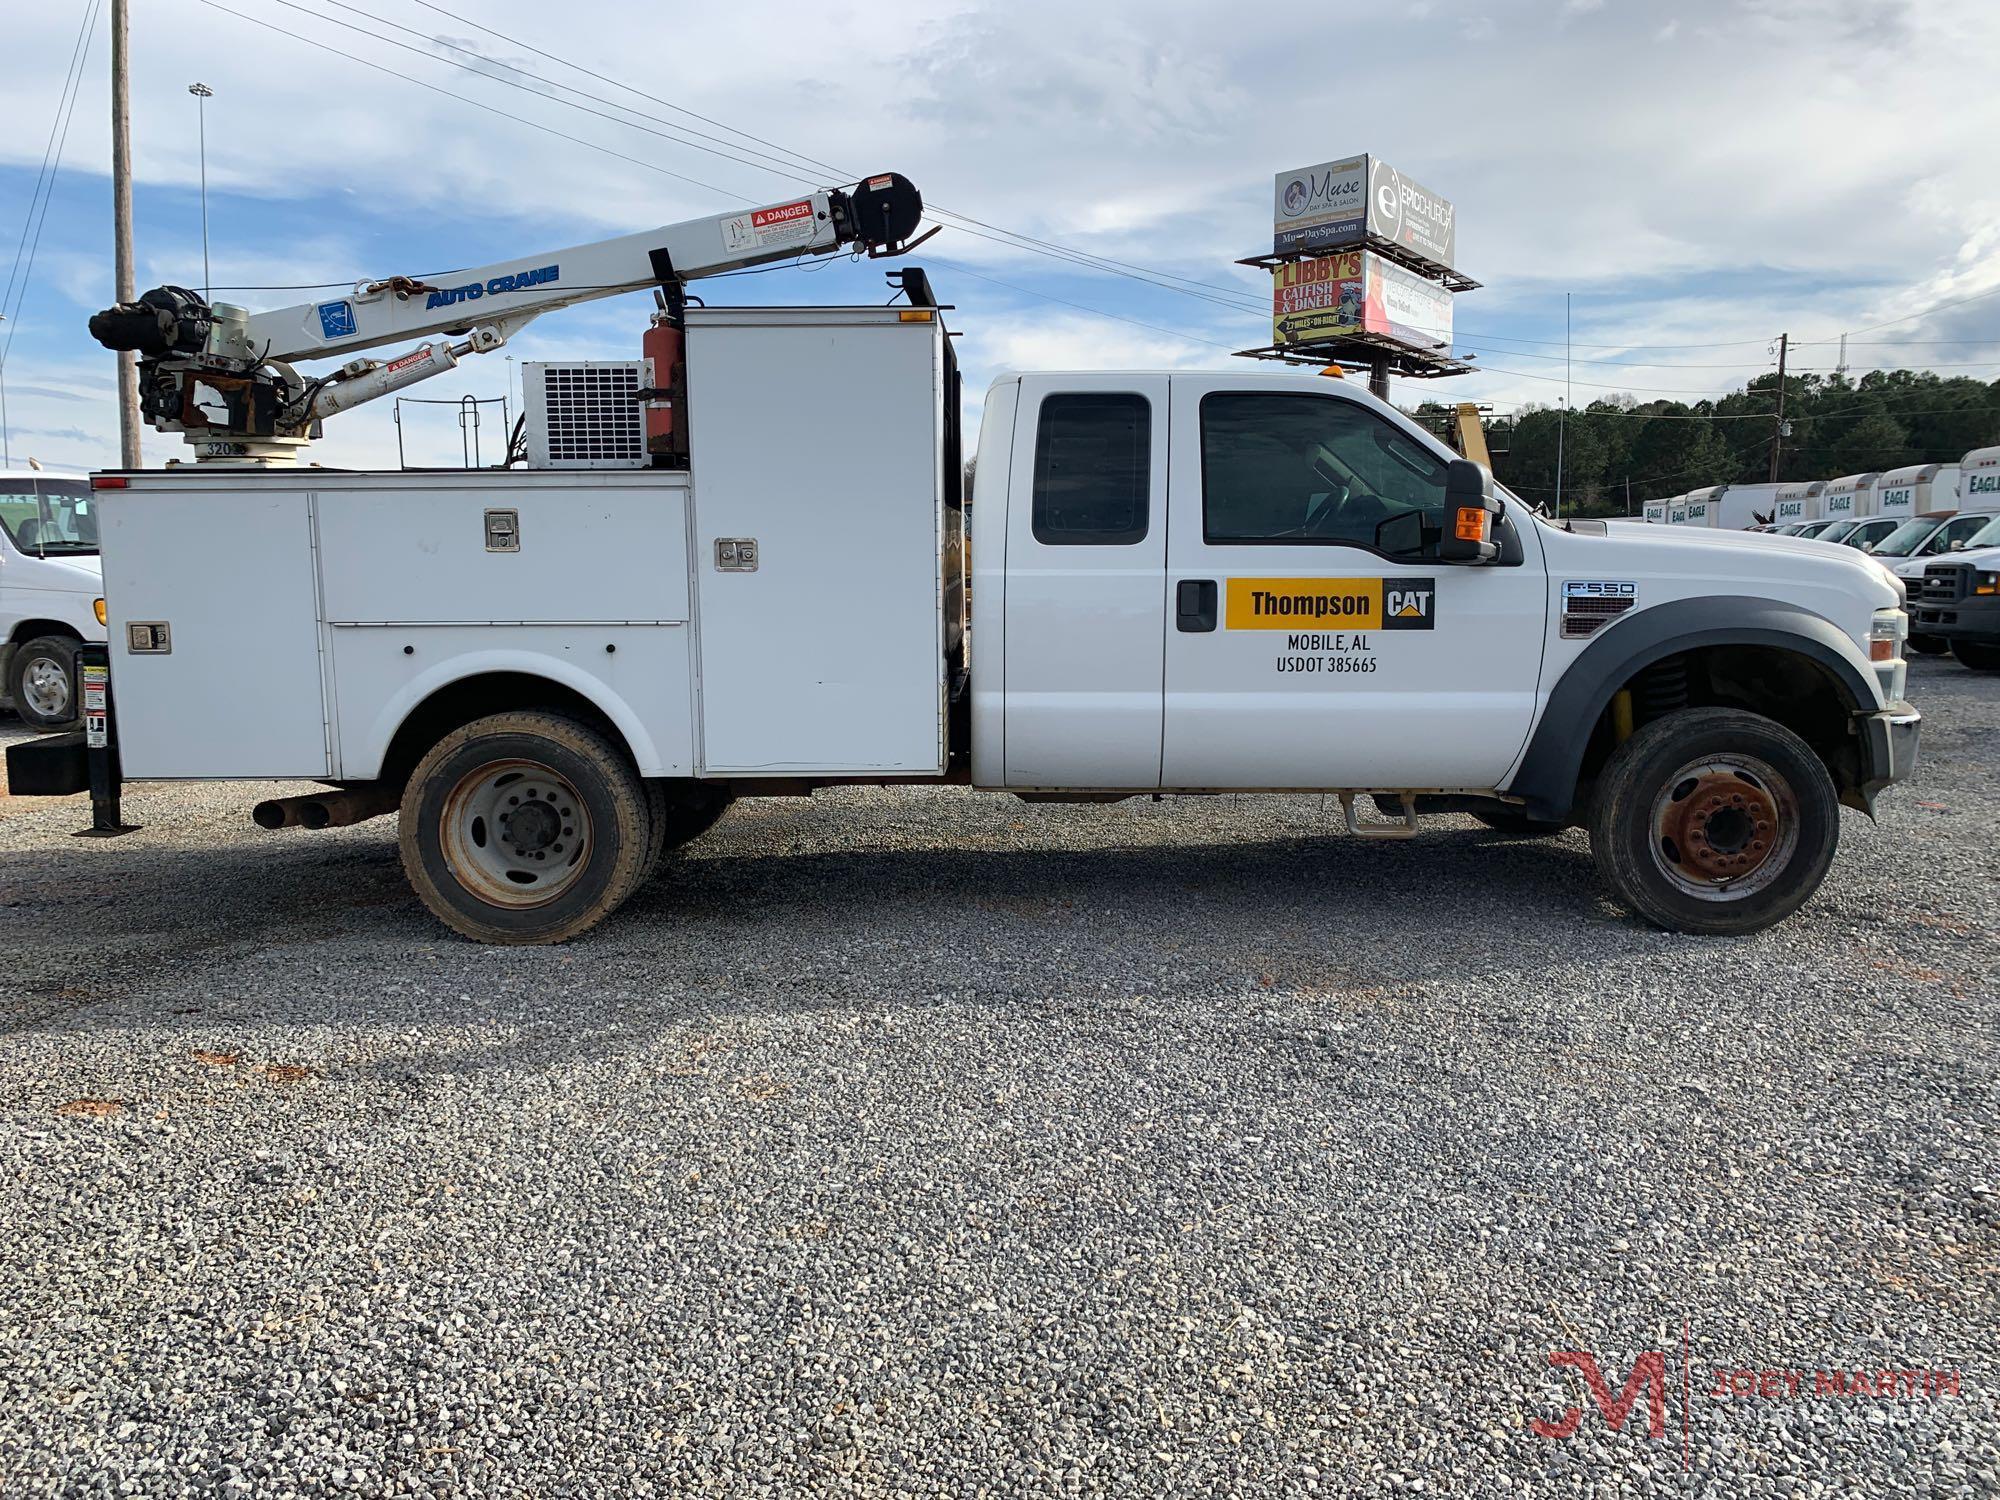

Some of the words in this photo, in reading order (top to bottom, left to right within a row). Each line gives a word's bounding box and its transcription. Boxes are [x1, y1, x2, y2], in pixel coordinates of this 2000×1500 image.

[1309, 170, 1360, 202] Muse
[1309, 203, 1320, 211] DAY
[1322, 201, 1332, 209] SPA
[1339, 197, 1359, 206] SALON
[767, 205, 809, 221] DANGER
[1283, 252, 1361, 287] LIBBY'S
[426, 283, 484, 310] AUTO
[487, 264, 560, 295] CRANE
[1282, 281, 1333, 301] CATFISH
[1282, 300, 1291, 313] &
[1295, 294, 1333, 312] DINER
[399, 350, 430, 367] DANGER
[1829, 497, 1851, 511] EAGLE
[1884, 490, 1909, 506] EAGLE
[1646, 508, 1662, 519] EAGLE
[1688, 505, 1705, 519] EAGLE
[1780, 503, 1801, 516] EAGLE
[1567, 583, 1634, 593] F-550
[1252, 592, 1369, 618] Thompson
[1387, 591, 1430, 617] CAT
[1288, 635, 1348, 653] MOBILE,
[1352, 635, 1371, 650] AL
[1277, 657, 1324, 672] USDOT
[1327, 657, 1377, 673] 385665
